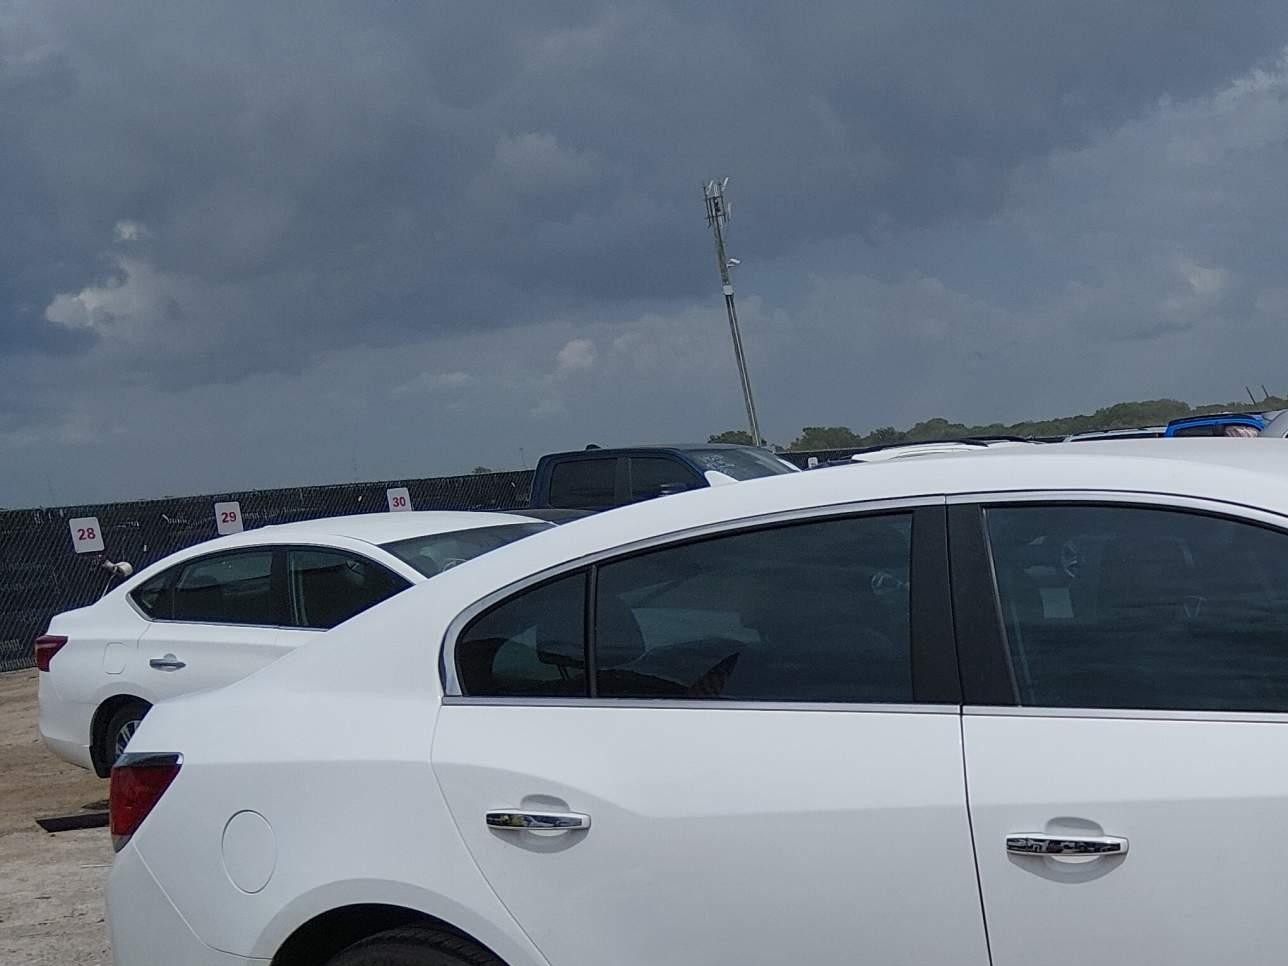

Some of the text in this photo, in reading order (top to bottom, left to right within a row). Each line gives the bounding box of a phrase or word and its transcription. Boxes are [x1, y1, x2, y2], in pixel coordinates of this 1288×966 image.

[392, 496, 406, 508] 30
[221, 511, 237, 524] 29
[77, 527, 96, 541] 28
